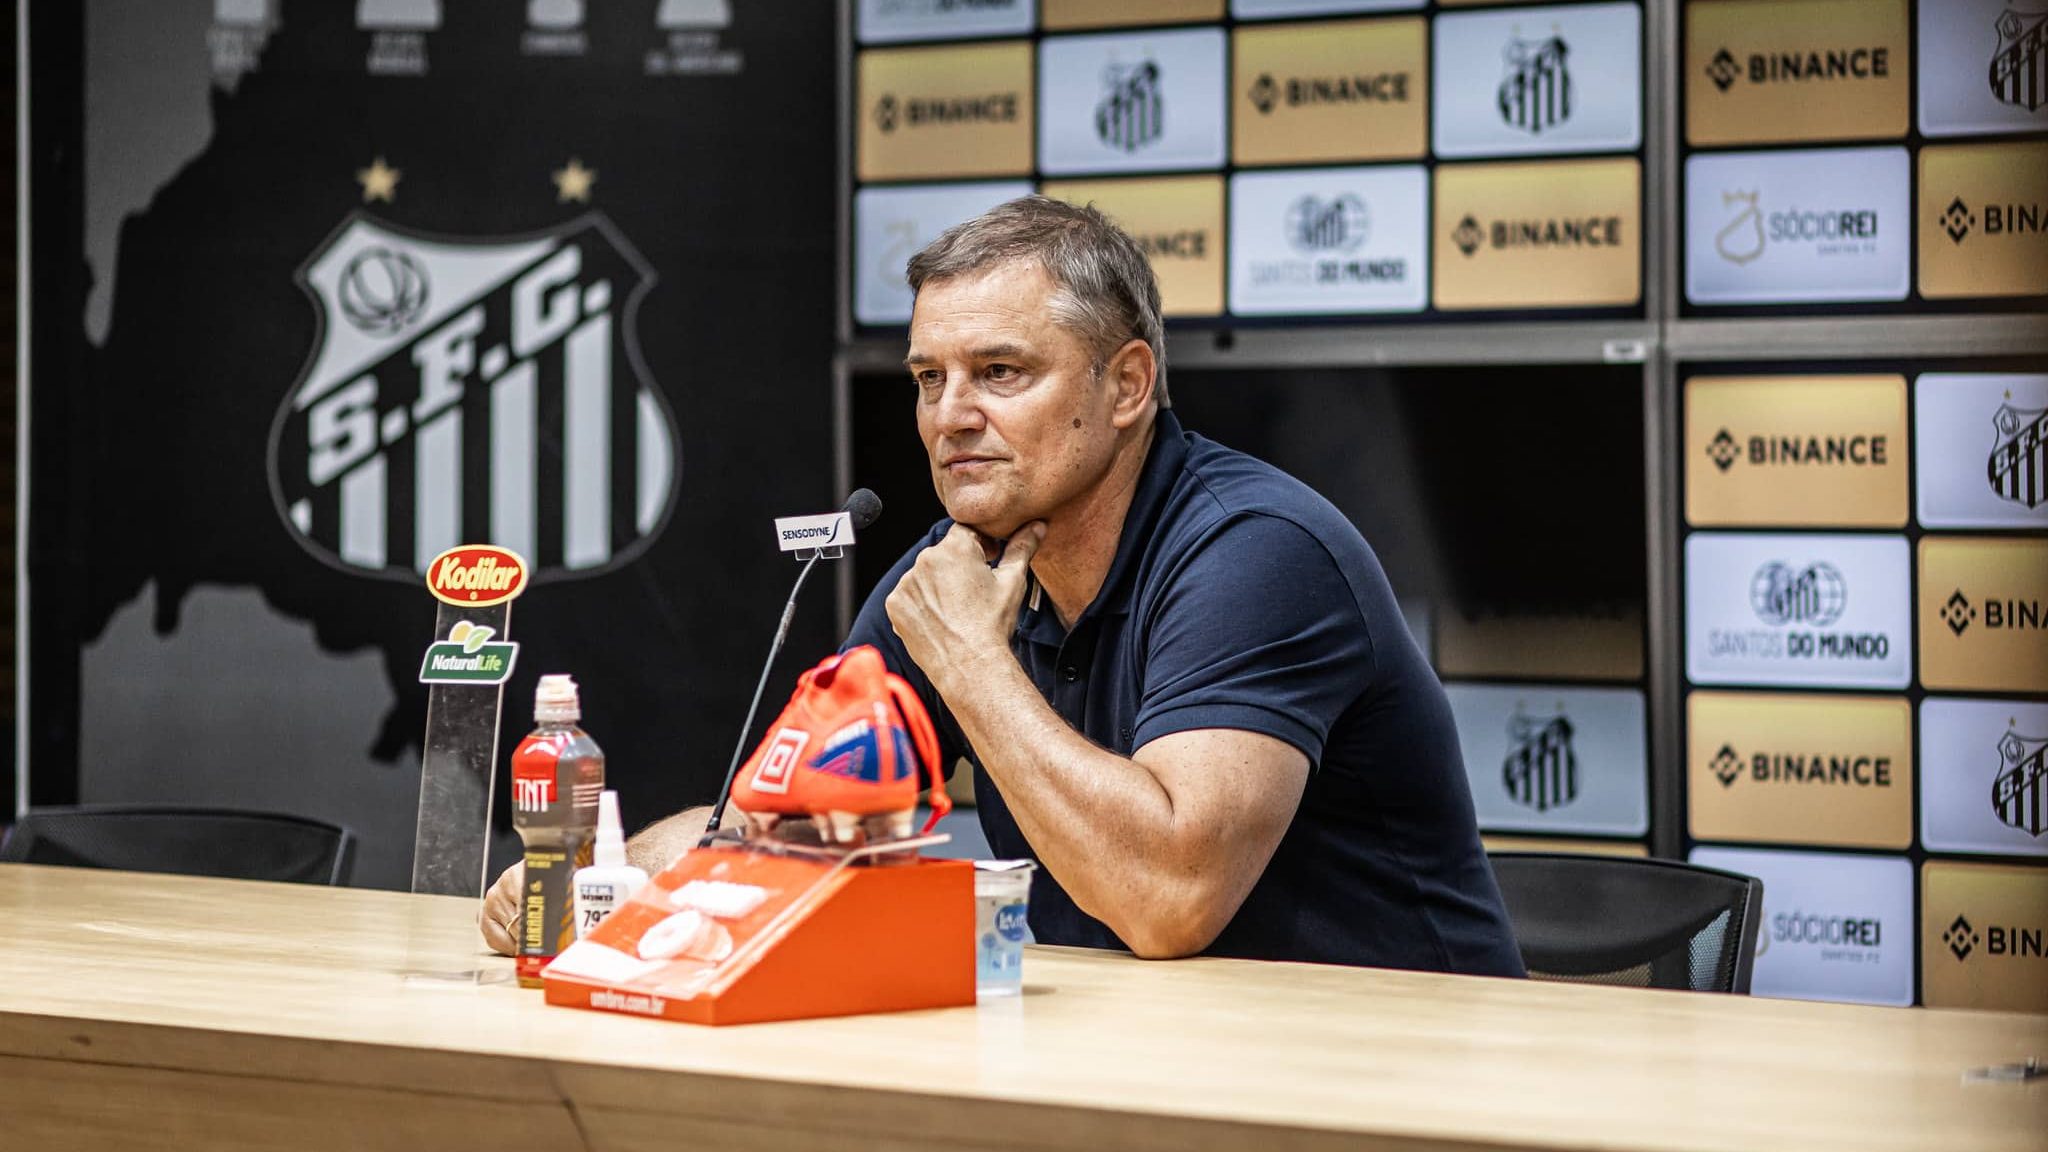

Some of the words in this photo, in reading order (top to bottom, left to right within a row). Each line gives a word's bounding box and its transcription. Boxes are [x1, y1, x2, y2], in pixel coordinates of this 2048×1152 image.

[1749, 49, 1889, 83] BINANCE
[1286, 73, 1409, 107] BINANCE
[905, 93, 1017, 124] BINANCE
[1491, 217, 1621, 248] BINANCE
[1985, 203, 2048, 234] BIN
[1749, 436, 1888, 465] BINANCE
[782, 526, 831, 540] SENSODYNE
[436, 556, 519, 590] Kodilar
[1985, 600, 2048, 629] BIN
[1788, 632, 1813, 657] DO
[1818, 633, 1889, 659] MUNDO
[1752, 754, 1891, 786] BINANCE
[515, 778, 552, 812] TNT
[1987, 926, 2048, 957] BIN
